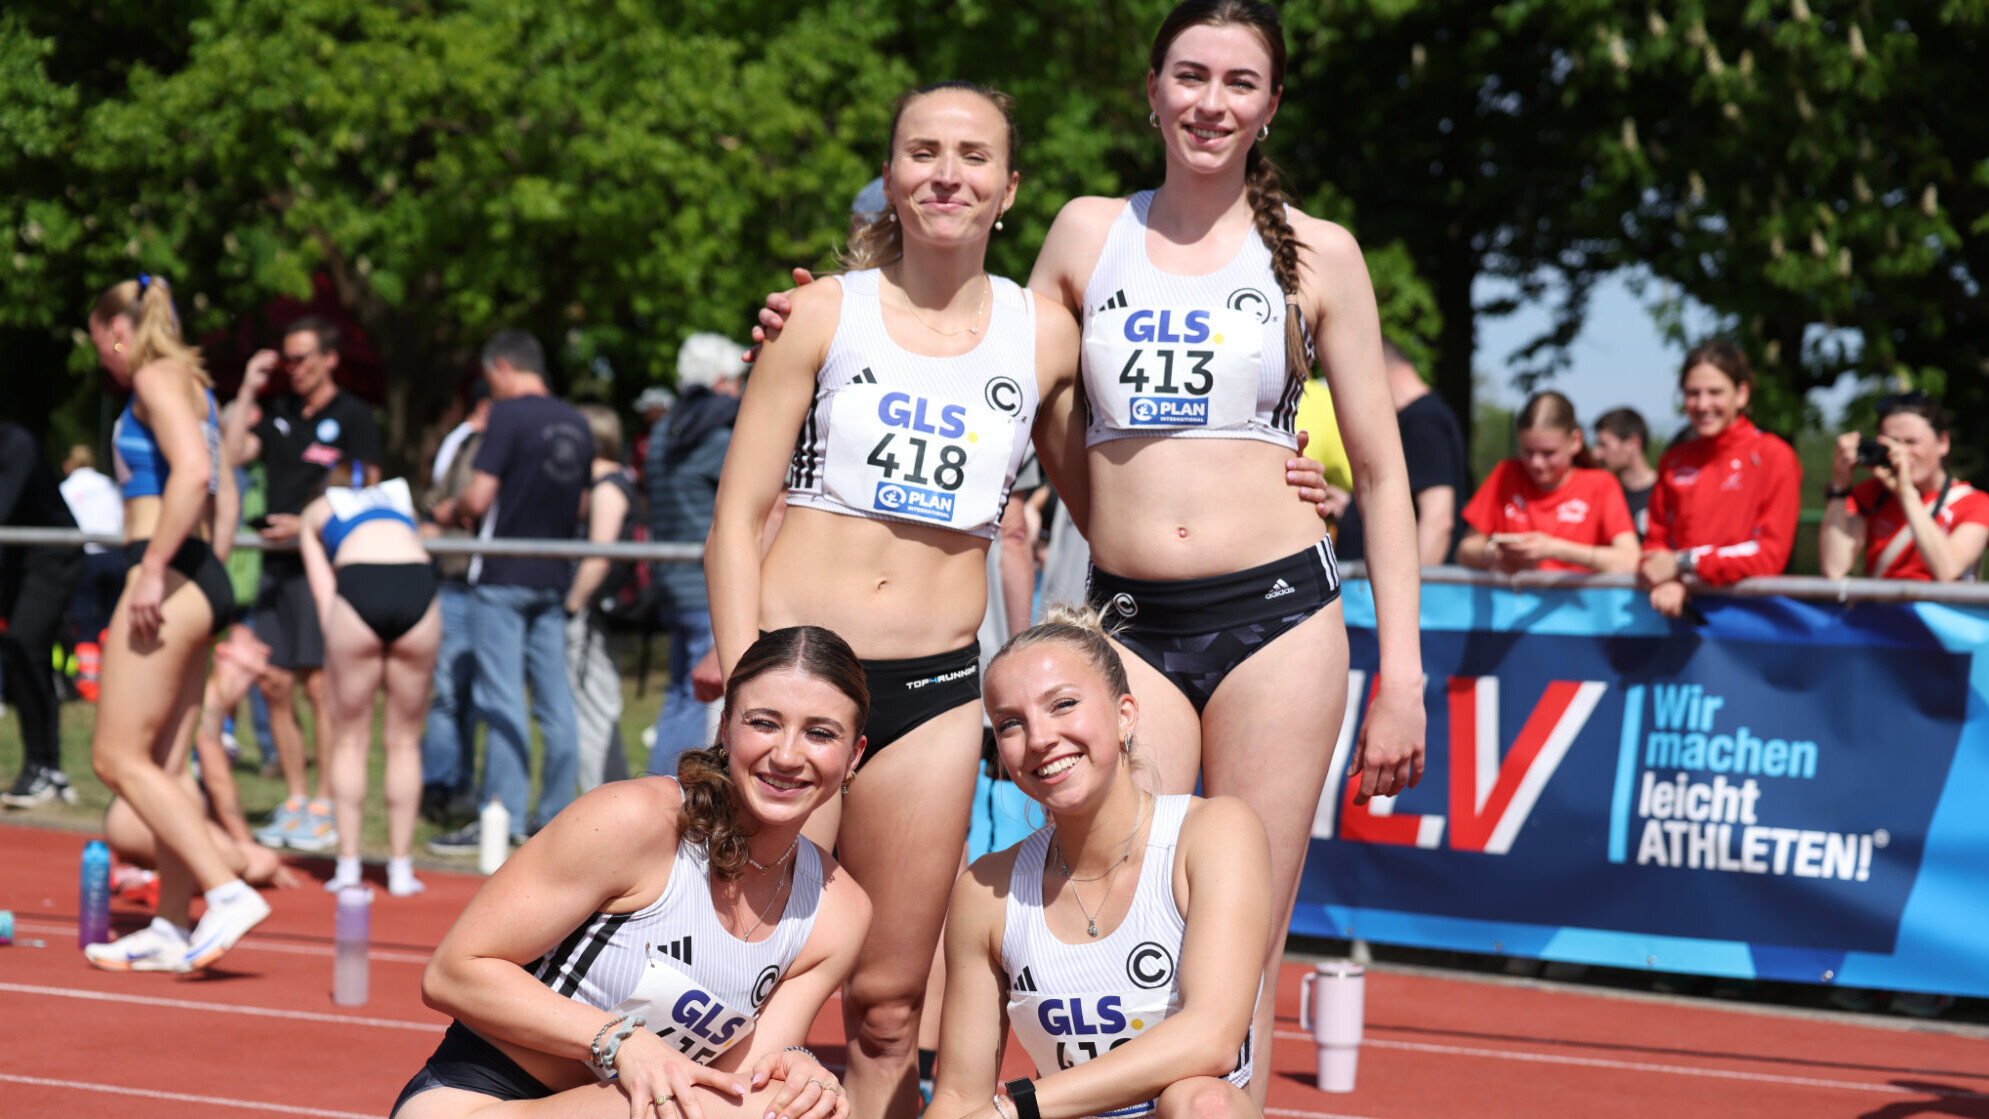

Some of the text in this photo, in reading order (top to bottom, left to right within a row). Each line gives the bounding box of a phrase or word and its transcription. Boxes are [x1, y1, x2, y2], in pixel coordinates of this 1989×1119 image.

[1118, 348, 1215, 396] 413
[1160, 401, 1206, 417] PLAN
[1160, 416, 1205, 426] INTERNATIONAL
[866, 432, 968, 492] 418
[907, 505, 951, 519] INTERNATIONAL
[908, 491, 953, 513] PLAN
[1264, 585, 1296, 600] adidas
[1653, 683, 1723, 733] Wir
[1645, 730, 1818, 779] machen
[1638, 771, 1760, 825] leicht
